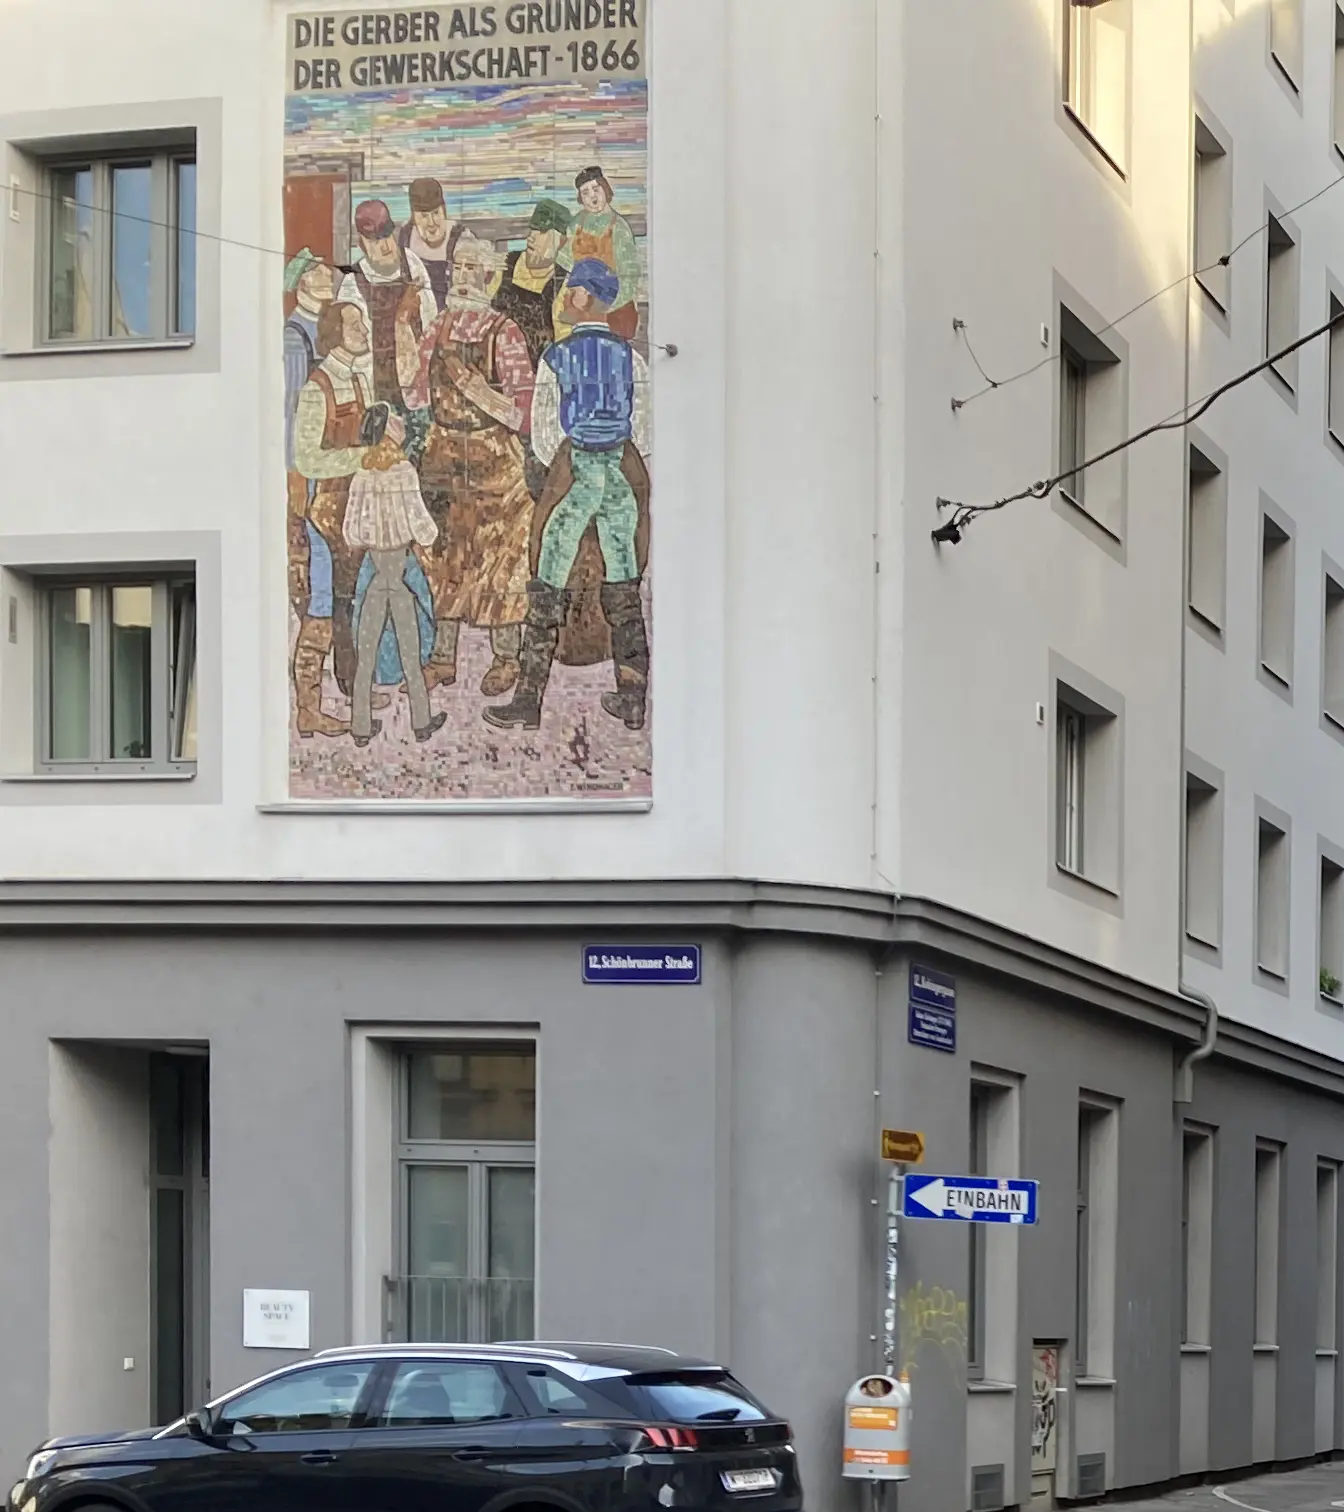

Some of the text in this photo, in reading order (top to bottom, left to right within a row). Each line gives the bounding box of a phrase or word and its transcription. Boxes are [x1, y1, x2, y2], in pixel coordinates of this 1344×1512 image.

[295, 17, 335, 49] DIE
[341, 10, 441, 47] GERBER
[448, 4, 497, 39] ALS
[294, 54, 342, 90] DER
[664, 955, 693, 969] Straße
[947, 1189, 1021, 1211] EINBAHN
[260, 1303, 294, 1312] BEAUTY
